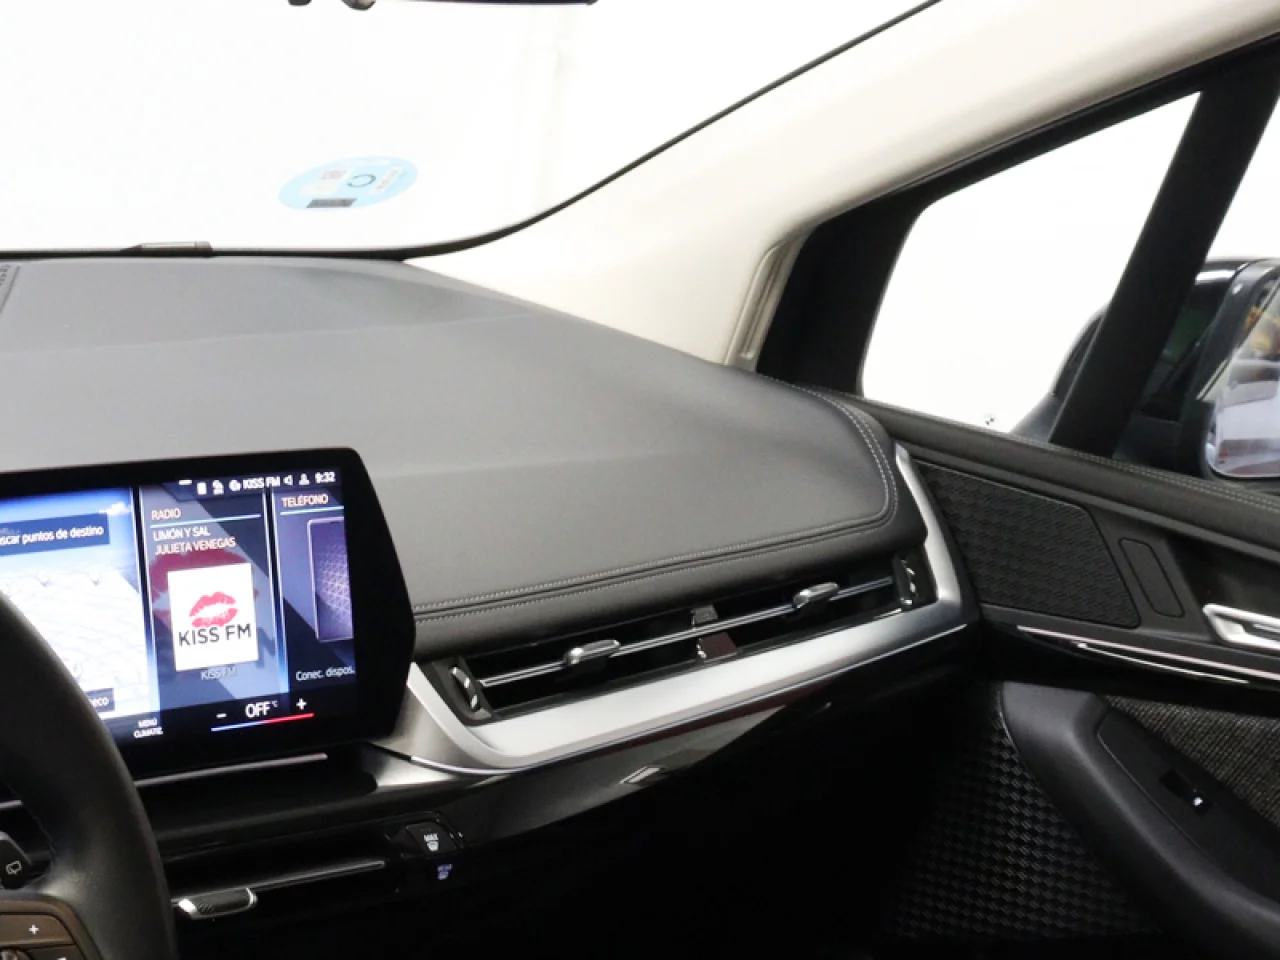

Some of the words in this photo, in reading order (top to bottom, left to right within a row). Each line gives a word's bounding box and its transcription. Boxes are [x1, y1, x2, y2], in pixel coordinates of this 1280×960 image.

[243, 478, 264, 489] KISS
[266, 476, 281, 487] FM
[314, 471, 336, 484] 9:32
[151, 508, 182, 521] RADIO
[22, 530, 53, 545] puntos
[56, 528, 68, 539] de
[70, 525, 104, 538] destino
[184, 528, 192, 538] Y
[192, 526, 211, 537] SAL
[154, 541, 193, 555] JULIETA
[193, 537, 236, 551] VENEGAS
[178, 627, 220, 647] KISS
[226, 623, 252, 640] FM
[201, 669, 221, 681] KISS
[296, 670, 324, 681] Conec.
[326, 666, 355, 679] dispos.
[245, 701, 270, 718] OFF
